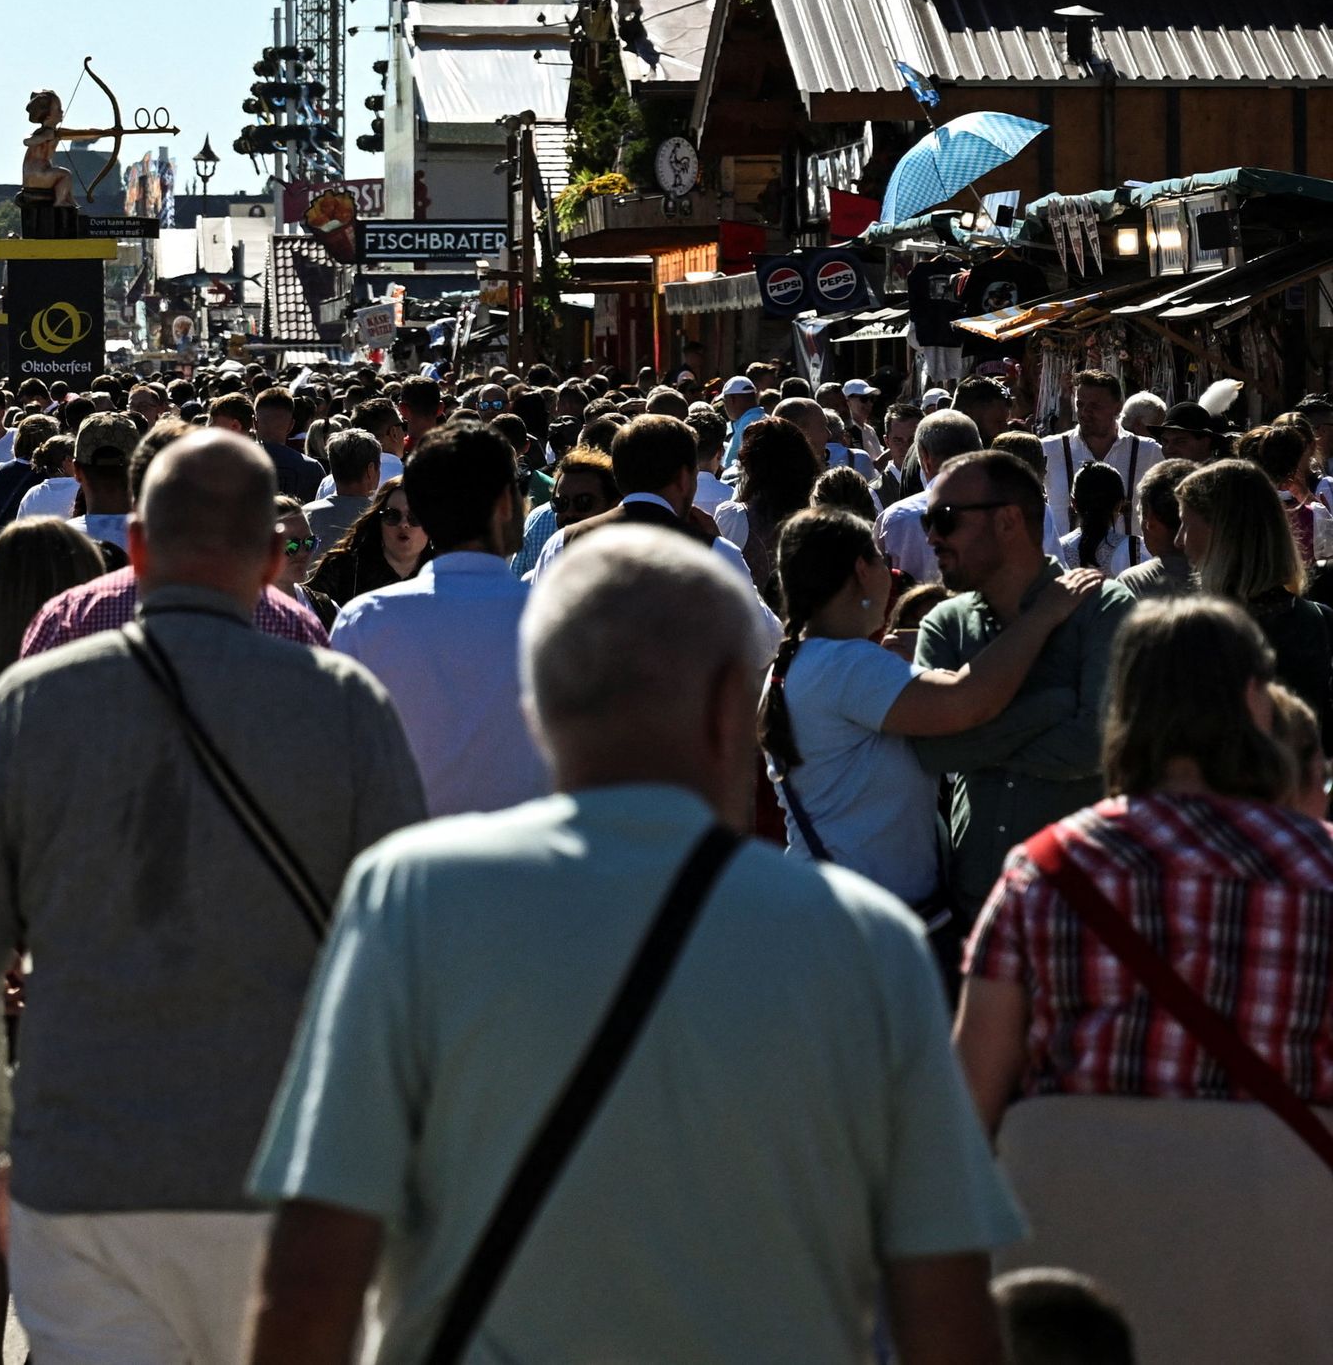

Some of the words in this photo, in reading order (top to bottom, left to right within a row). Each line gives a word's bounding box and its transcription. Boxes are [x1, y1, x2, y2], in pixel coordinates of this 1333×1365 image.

[769, 280, 801, 292] PEPSI
[820, 275, 854, 288] PEPSI
[21, 360, 92, 375] Oktoberfest
